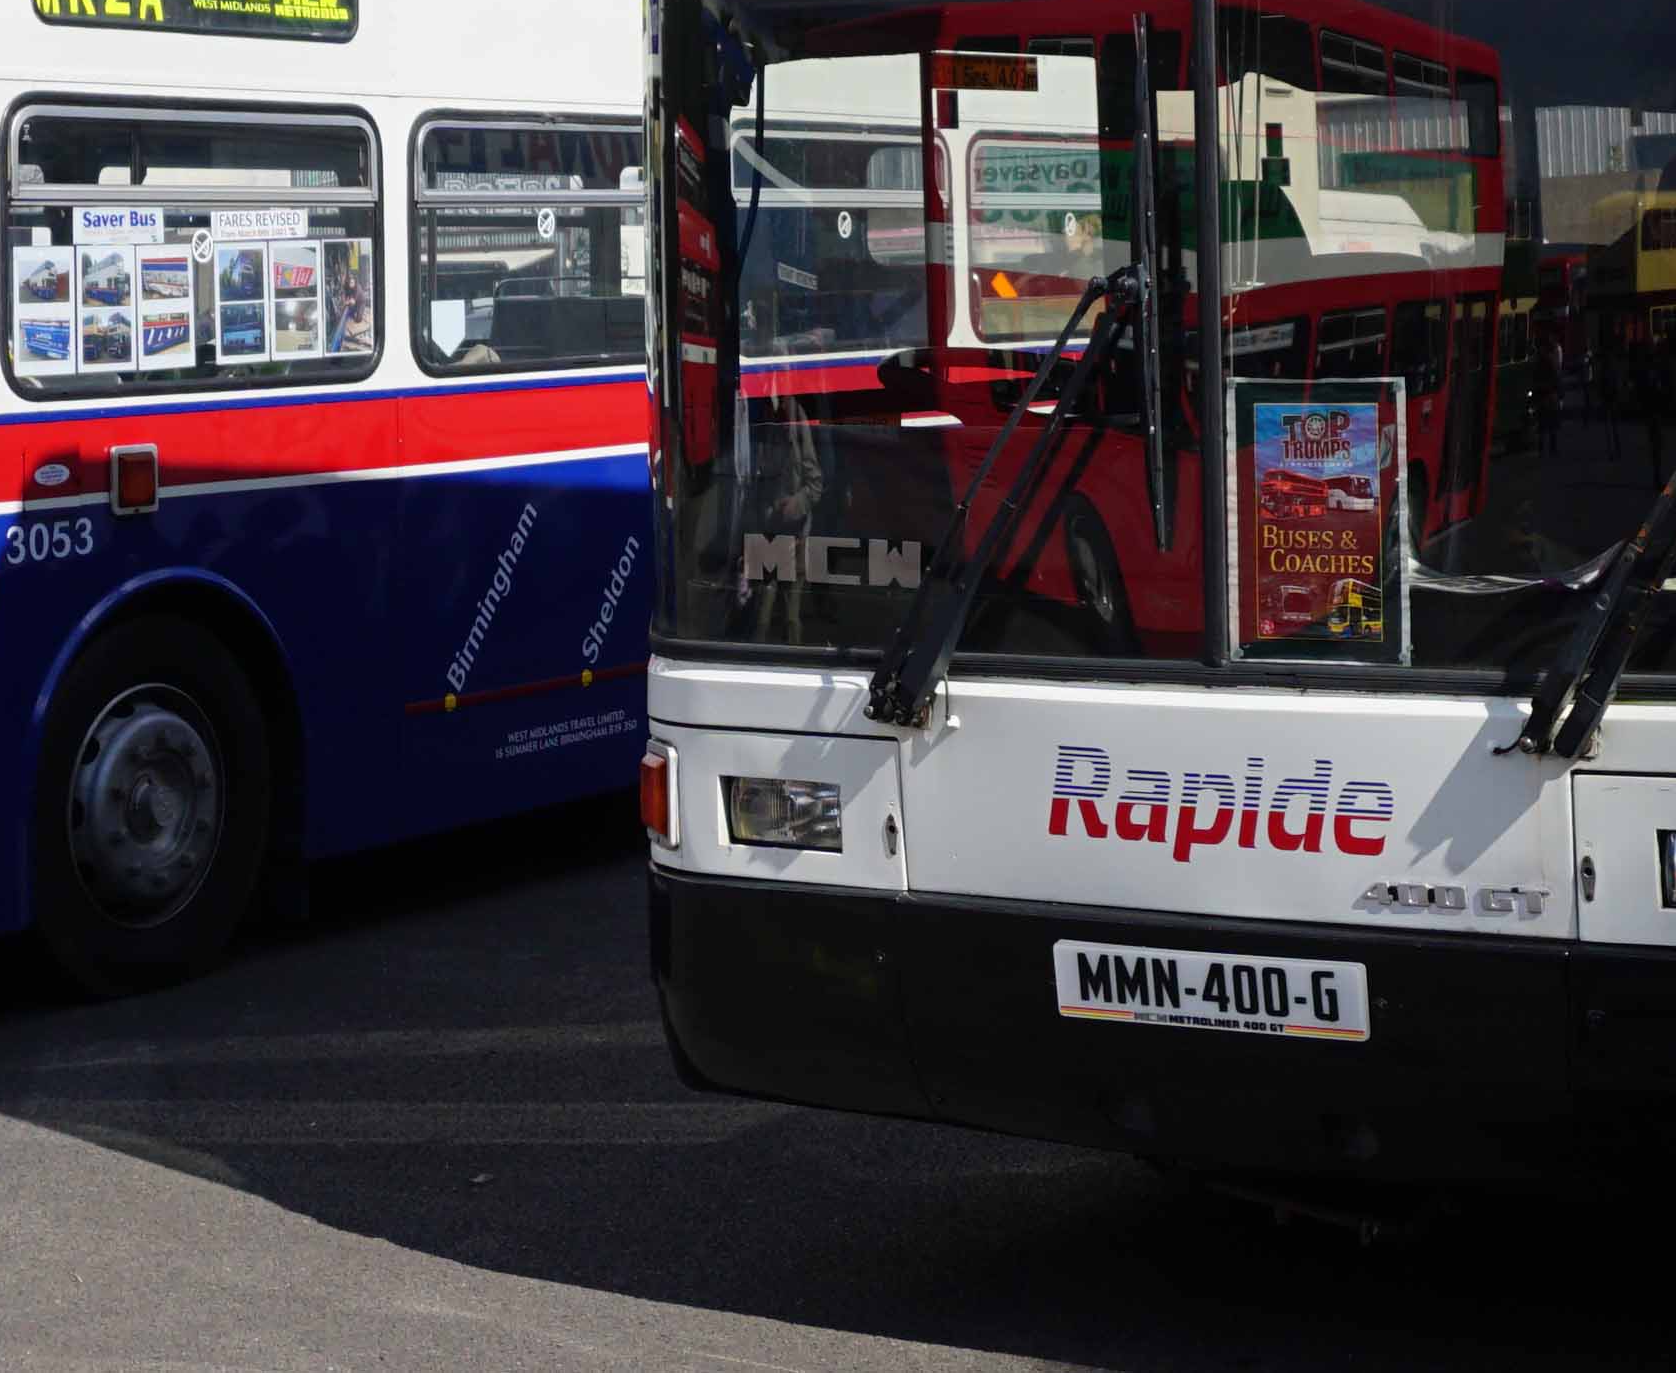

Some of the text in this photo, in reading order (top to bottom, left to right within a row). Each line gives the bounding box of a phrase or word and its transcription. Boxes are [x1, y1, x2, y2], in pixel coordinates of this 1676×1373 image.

[219, 0, 271, 13] MIDLANDS
[82, 210, 157, 228] Saver Bus
[218, 211, 300, 227] FARES REVISED
[1281, 410, 1351, 440] TOP
[1282, 440, 1352, 461] TRUMPS
[5, 517, 95, 565] 3053
[1262, 525, 1358, 550] BUSES &
[745, 533, 922, 589] MCW
[1269, 549, 1374, 575] COACHES
[446, 499, 540, 694] Birmingham
[582, 533, 641, 665] Sheldon
[1049, 745, 1394, 863] Rapide
[1361, 882, 1550, 916] 400 GT
[1077, 952, 1339, 1022] MMN-400-G
[1169, 1014, 1242, 1030] METROLINER
